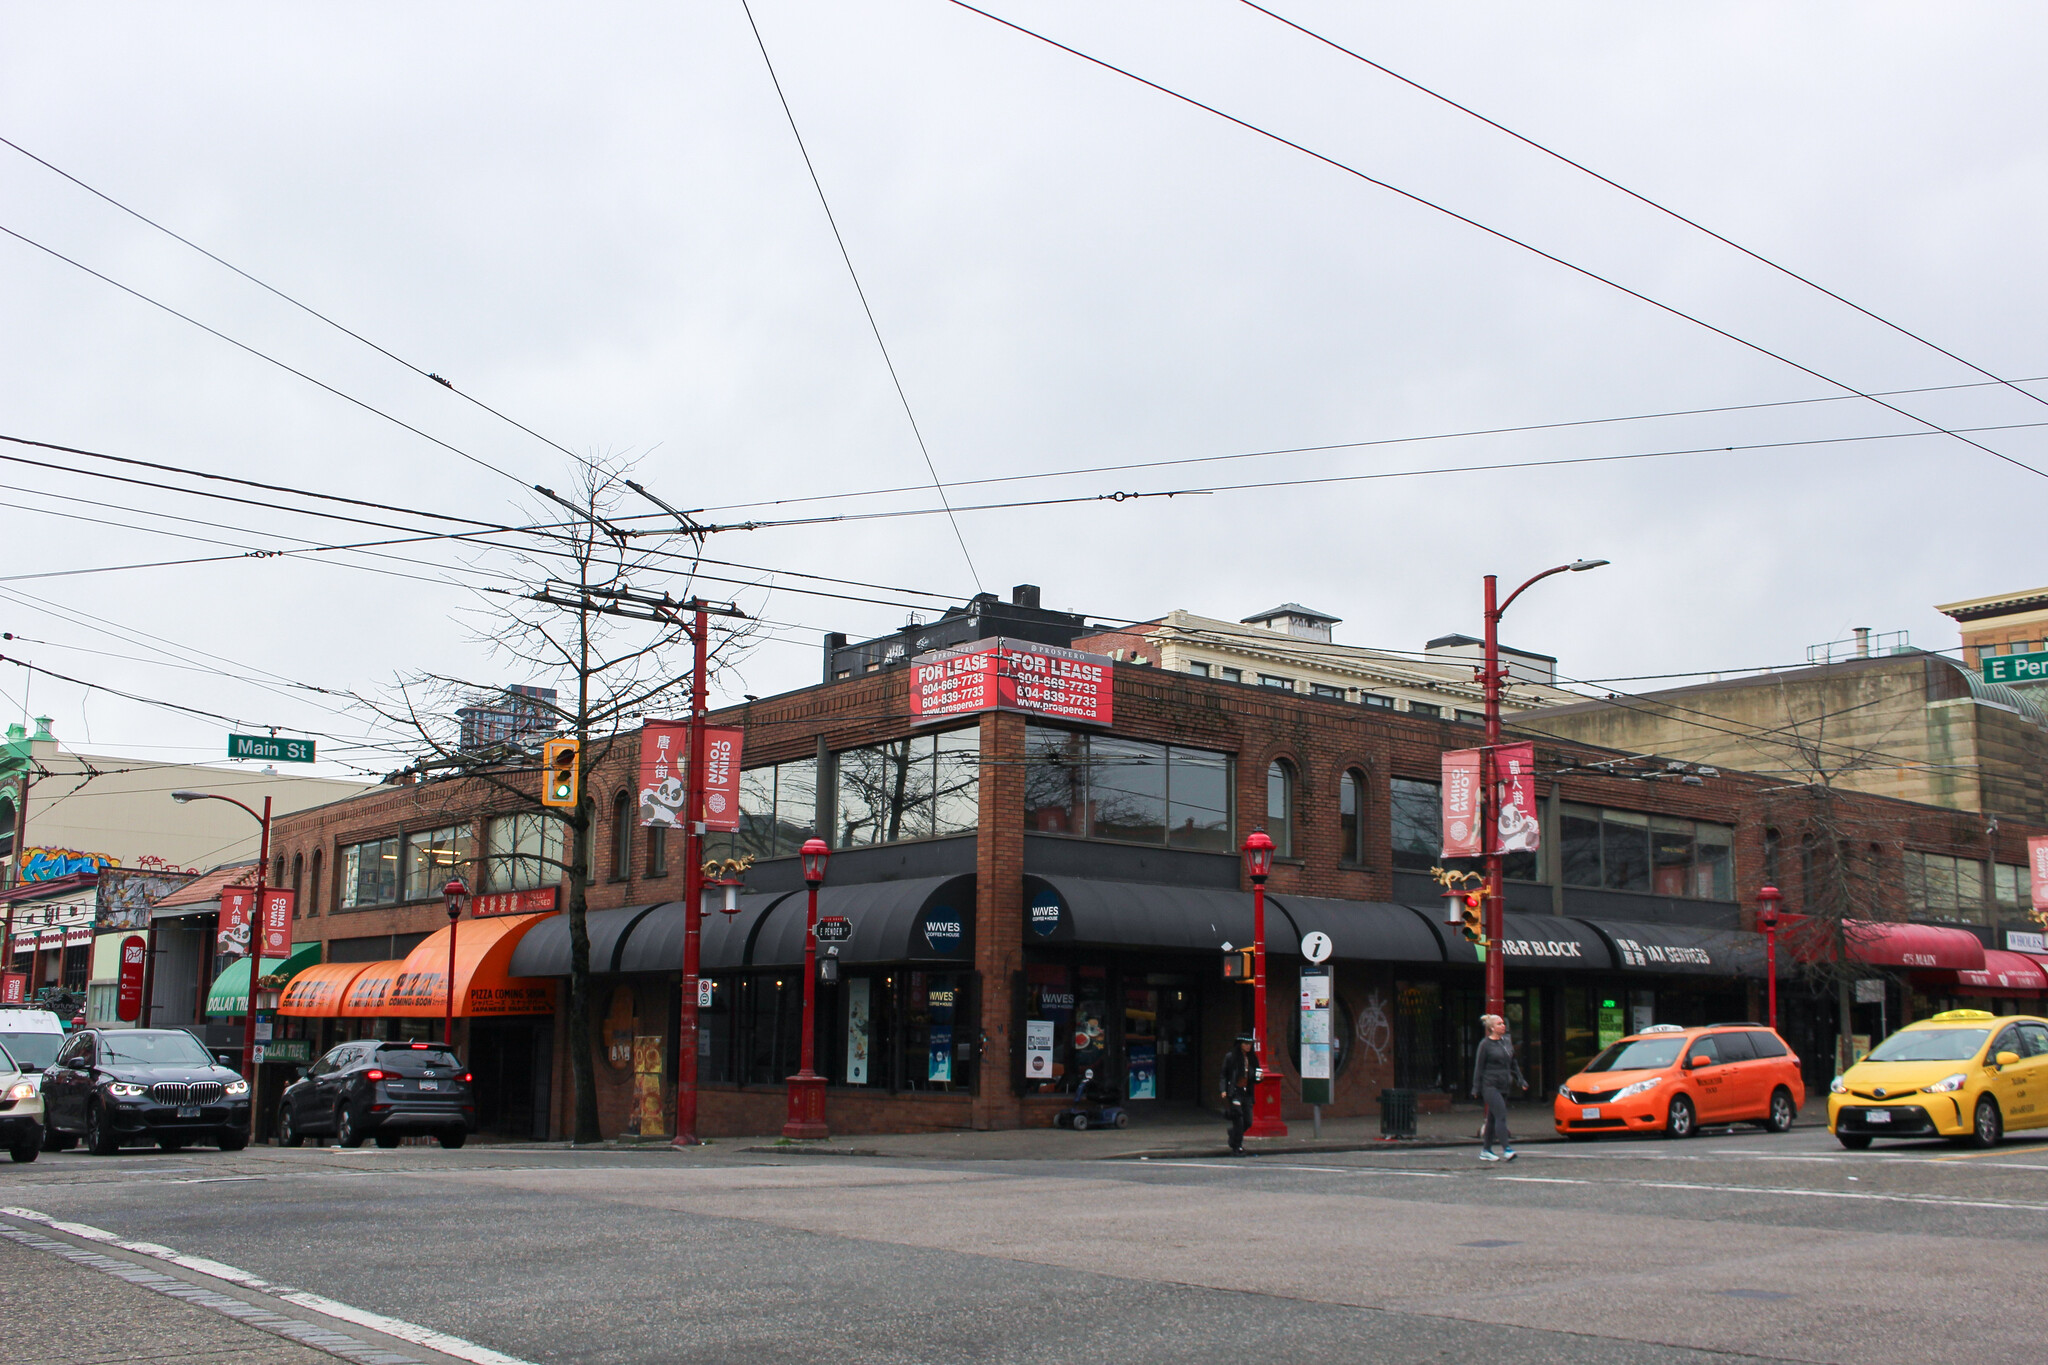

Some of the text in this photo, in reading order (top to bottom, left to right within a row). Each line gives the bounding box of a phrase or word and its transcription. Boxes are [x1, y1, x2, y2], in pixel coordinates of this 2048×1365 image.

[1039, 647, 1085, 660] PROSPERO
[918, 653, 988, 683] FOR LEASE
[1012, 652, 1102, 683] FOR LEASE
[1992, 660, 2006, 679] E
[922, 673, 984, 695] 604-669-7733
[1017, 671, 1097, 695] 604-669-7733
[922, 685, 984, 708] 604-839-7733
[1016, 685, 1097, 708] 604-839-7733
[922, 698, 984, 717] www.prospero.ca
[1016, 698, 1097, 717] www.prospero.ca
[238, 739, 306, 758] Main St
[655, 735, 671, 779] 唐人街
[708, 740, 721, 784] TOWN
[718, 741, 731, 785] CHINA
[270, 897, 280, 927] TOWN
[277, 898, 287, 928] CHINA
[1032, 906, 1059, 916] WAVES
[926, 921, 960, 932] WAVES
[1530, 940, 1581, 957] BLOCK
[1643, 945, 1711, 965] TAX SERVICES
[1914, 953, 1937, 966] MAIN
[471, 988, 493, 1000] PIZZA
[494, 987, 524, 1000] COMING
[929, 991, 954, 1002] WAVES
[1042, 993, 1075, 1004] WAVES
[207, 996, 249, 1012] DOLLAR TRE
[264, 1044, 304, 1058] OLLAR TREE
